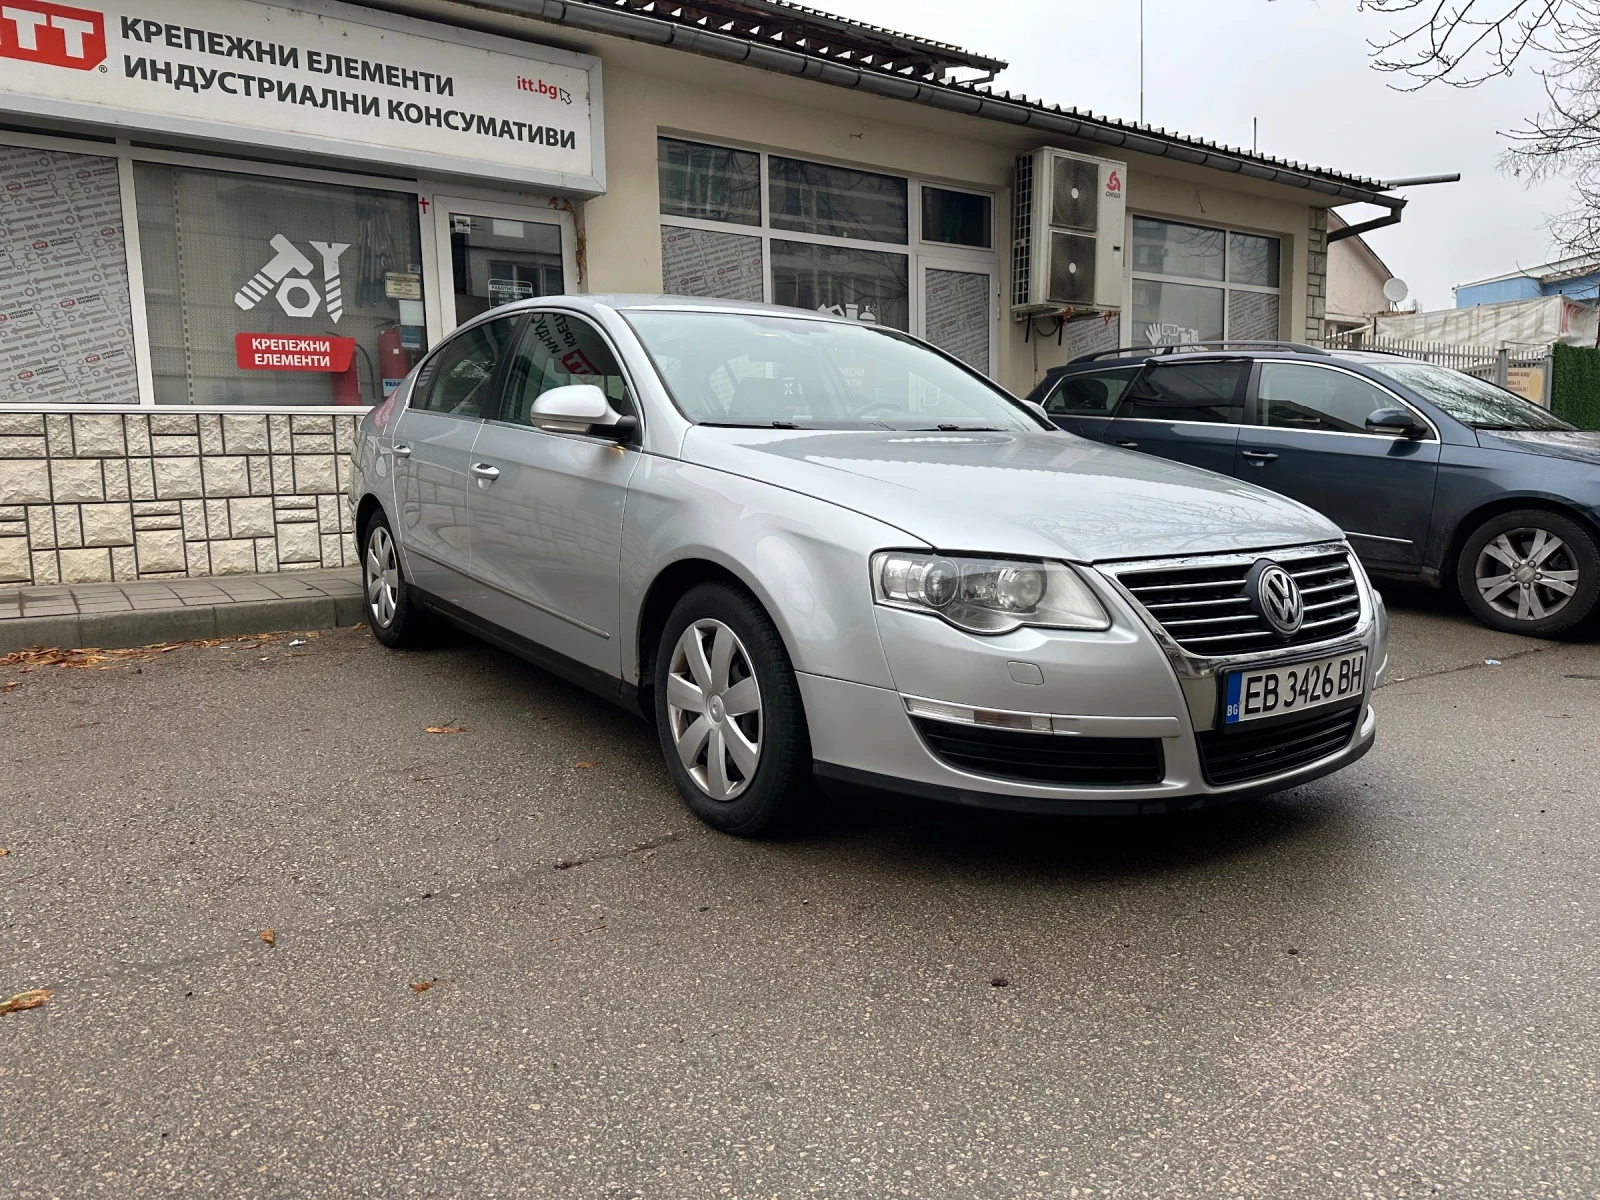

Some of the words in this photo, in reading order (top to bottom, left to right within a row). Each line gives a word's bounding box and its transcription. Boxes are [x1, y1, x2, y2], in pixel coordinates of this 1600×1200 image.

[0, 6, 94, 59] ТТ
[120, 15, 299, 69] КРЕПЕЖНИ
[306, 50, 454, 97] ЕЛЕМЕНТИ
[516, 75, 558, 100] itt.bg
[123, 54, 380, 117] ИНДУСТРИАЛНИ
[387, 98, 576, 150] КОНСУМАТИВИ
[1105, 190, 1121, 199] CHIGO
[251, 338, 331, 352] КРЕПЕЖНИ
[254, 353, 331, 367] ЕЛЕМЕНТИ
[1244, 674, 1279, 715] EB
[1283, 662, 1335, 708] 3426
[1338, 656, 1363, 695] BH
[1226, 703, 1240, 717] BG
